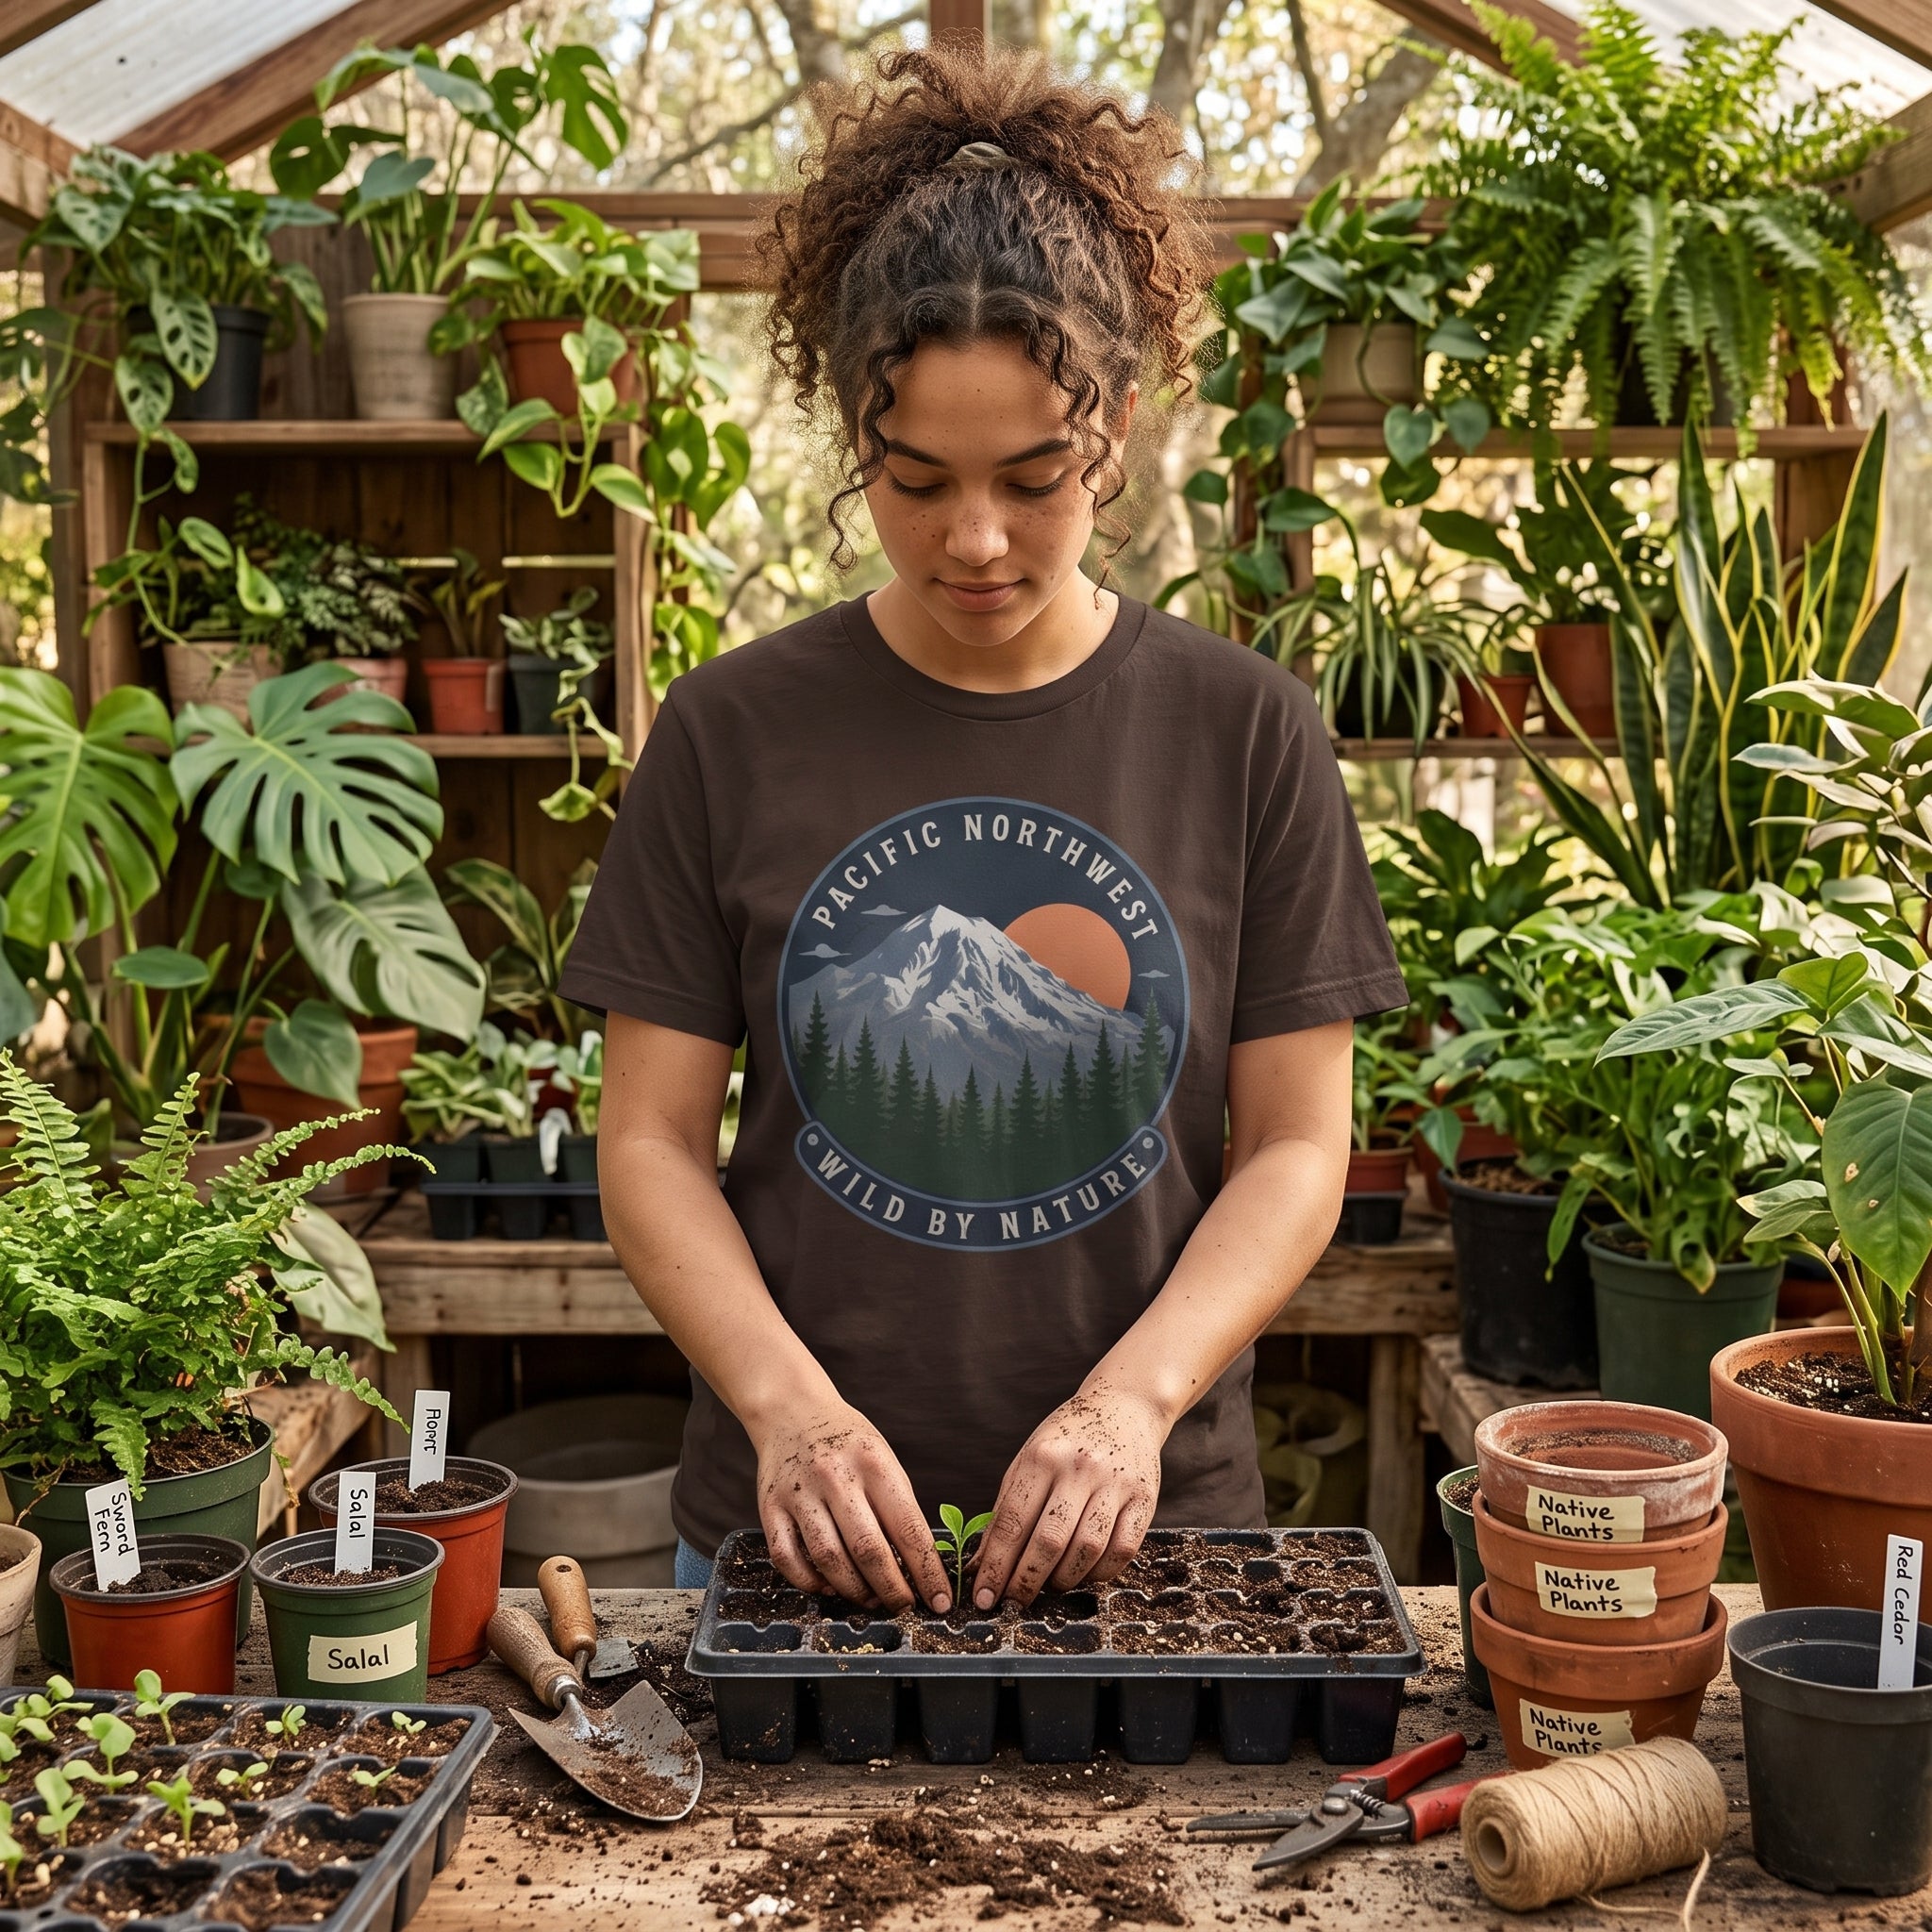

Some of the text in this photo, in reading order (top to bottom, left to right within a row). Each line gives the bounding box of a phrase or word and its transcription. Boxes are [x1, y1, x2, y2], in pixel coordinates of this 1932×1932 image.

[811, 813, 1159, 941] PACIFIC NORTHWEST
[816, 1147, 1147, 1241] WILD BY NATURE
[110, 1491, 135, 1557] Sword
[347, 1487, 370, 1540] Salal
[1538, 1493, 1615, 1521] Native
[93, 1507, 111, 1553] Fern
[1541, 1514, 1614, 1541] Plants
[1544, 1569, 1620, 1591] Native
[1893, 1544, 1914, 1645] Red Cedar
[1550, 1591, 1624, 1613] Plants
[326, 1643, 390, 1670] Salal
[1529, 1709, 1602, 1737] Native
